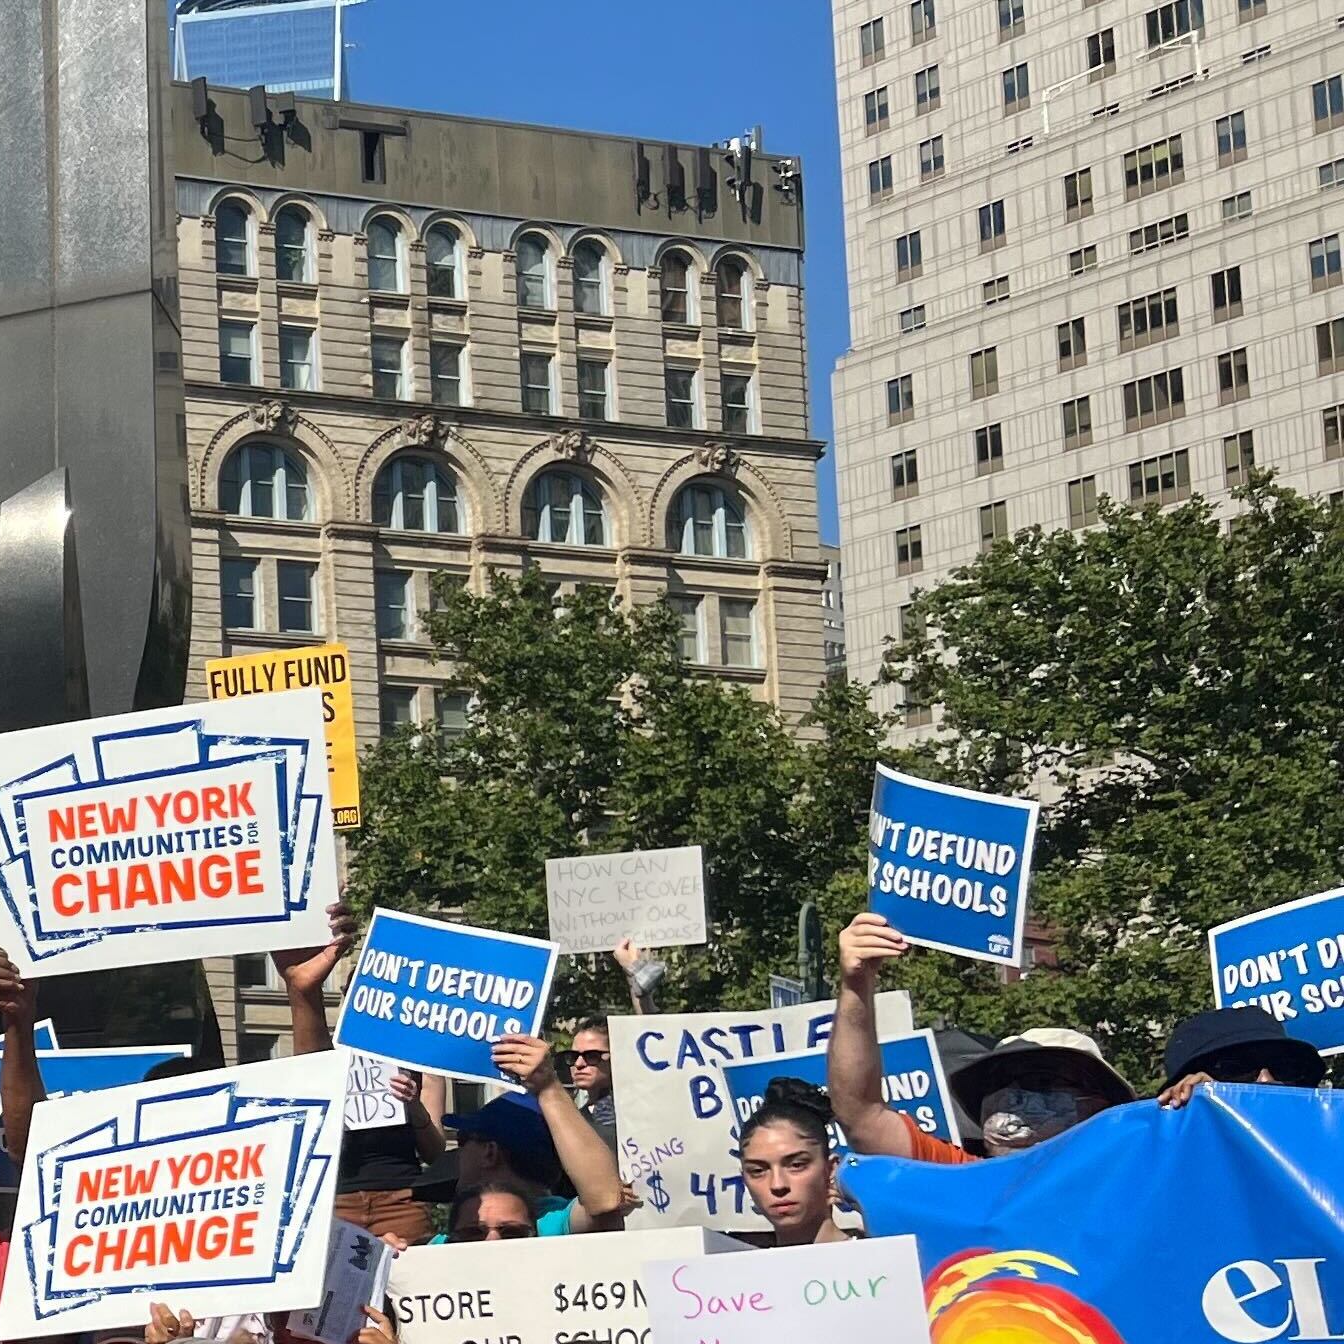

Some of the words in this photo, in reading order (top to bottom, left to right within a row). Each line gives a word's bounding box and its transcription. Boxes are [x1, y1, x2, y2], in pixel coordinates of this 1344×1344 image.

[211, 662, 276, 699] FULLY
[284, 653, 346, 690] FUND
[48, 797, 139, 843] NEW
[144, 782, 257, 826] YORK
[51, 824, 243, 869] COMMUNITIES
[248, 820, 259, 845] FOR
[558, 862, 611, 881] HOW
[620, 856, 668, 875] CAN
[907, 826, 1016, 876] DEFUND
[52, 850, 264, 918] CHANGE
[554, 887, 605, 908] NYC
[880, 861, 1007, 917] SCHOOLS
[361, 948, 425, 988] DON'T
[426, 964, 534, 1010] DEFUND
[1223, 943, 1309, 994] DON'T
[353, 985, 396, 1021] OUR
[75, 1152, 162, 1205] NEW
[168, 1144, 268, 1192] YORK
[74, 1184, 251, 1231] COMMUNITIES
[254, 1182, 266, 1206] FOR
[62, 1210, 261, 1279] CHANGE
[671, 1264, 774, 1321] Save
[802, 1273, 889, 1308] our
